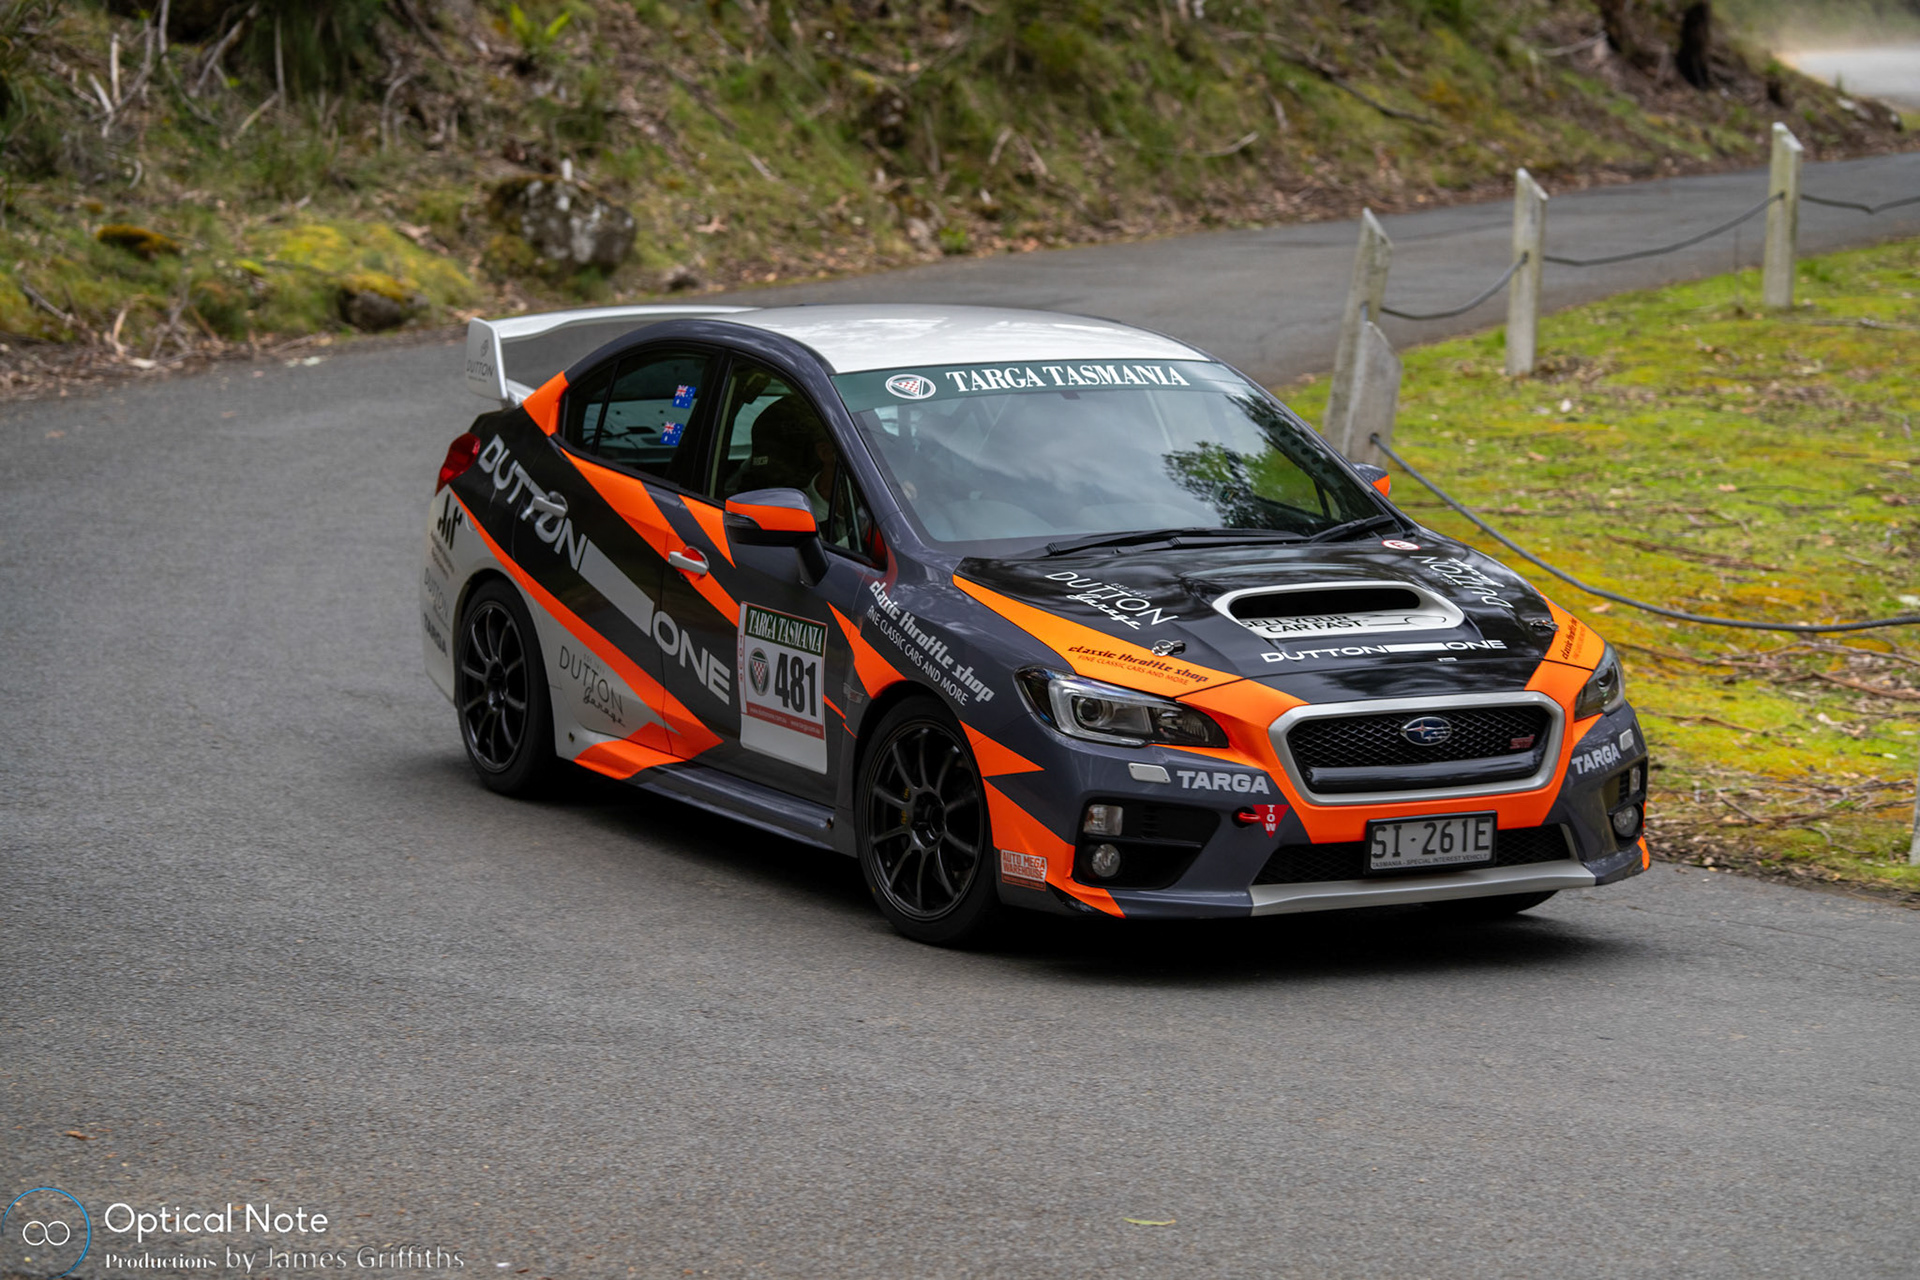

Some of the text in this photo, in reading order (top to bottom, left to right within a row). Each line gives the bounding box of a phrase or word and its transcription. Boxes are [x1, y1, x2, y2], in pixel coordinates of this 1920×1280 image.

[946, 364, 1190, 392] TARGA TASMANIA
[478, 434, 588, 571] DUTTON
[1044, 571, 1179, 625] DUTTON
[1409, 555, 1515, 609] DUTTON
[747, 609, 824, 654] TARGA TASMANIA
[869, 580, 995, 702] classic throttle shop
[1265, 620, 1363, 633] CAR FAST
[1445, 639, 1507, 650] ONE
[652, 610, 731, 706] ONE
[880, 619, 906, 651] CLASSIC
[904, 643, 924, 667] CARS
[921, 660, 941, 682] AND
[940, 676, 969, 706] MORE
[1067, 645, 1209, 683] classic throttle shop
[1260, 643, 1389, 663] DUTTON
[560, 645, 624, 717] DUTTON
[774, 651, 817, 718] 481
[1571, 743, 1622, 775] TARGA
[1176, 770, 1271, 795] TARGA
[1265, 804, 1276, 832] TOW
[1023, 855, 1046, 869] MEGA
